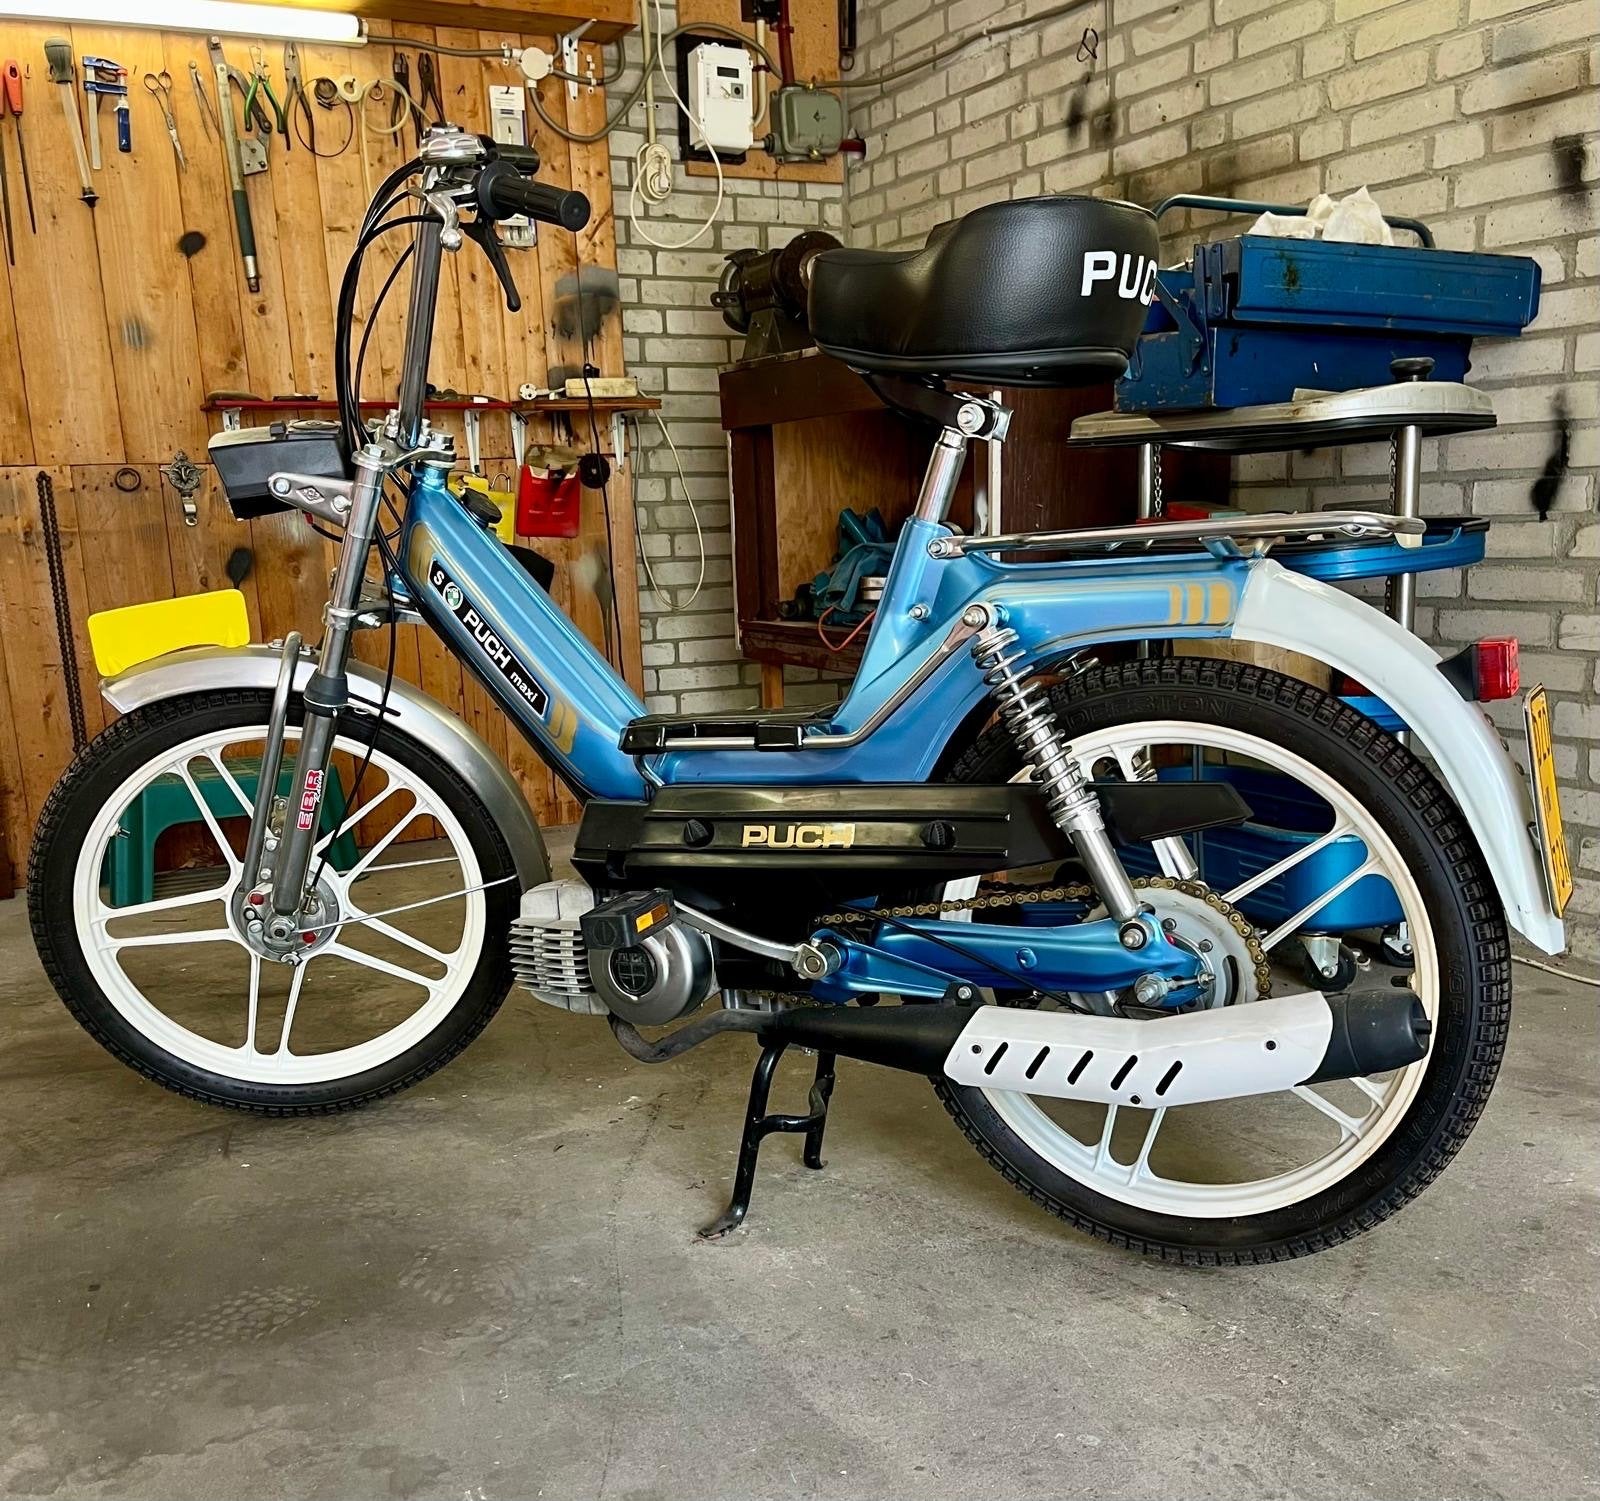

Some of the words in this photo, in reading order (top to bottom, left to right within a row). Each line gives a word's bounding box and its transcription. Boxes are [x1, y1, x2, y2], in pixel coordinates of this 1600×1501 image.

[1080, 251, 1157, 307] PUC
[433, 570, 445, 586] S
[462, 609, 511, 670] PUCH
[509, 671, 538, 703] maxi
[297, 769, 322, 830] EBR
[741, 823, 856, 848] PUCH
